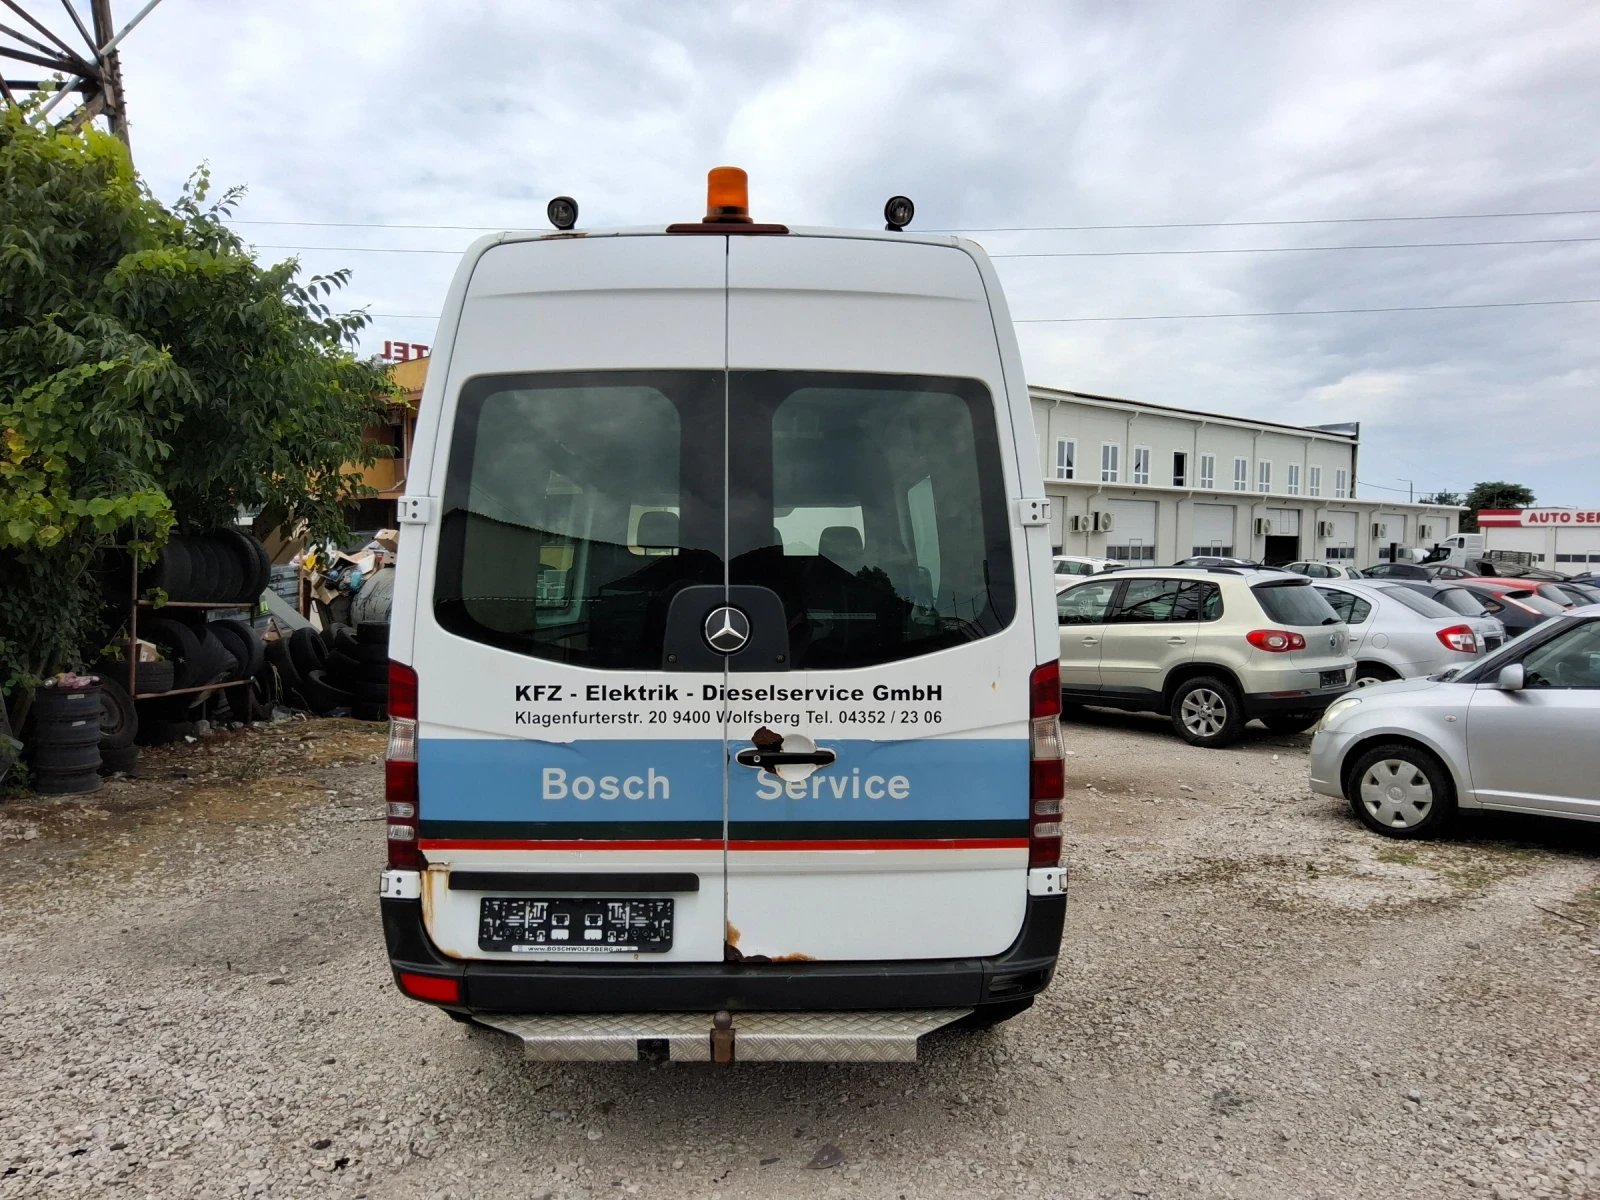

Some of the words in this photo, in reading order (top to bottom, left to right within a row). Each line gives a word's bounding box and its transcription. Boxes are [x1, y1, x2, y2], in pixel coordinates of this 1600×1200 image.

[1528, 512, 1571, 523] AUTO
[515, 685, 563, 701] KFZ
[586, 685, 679, 701] Elektrik
[702, 684, 864, 701] Dieselservice
[872, 685, 943, 701] GmbH
[515, 711, 643, 727] Klagenfurterstr.
[648, 711, 667, 724] 20
[672, 711, 711, 724] 9400
[716, 710, 800, 727] Wolfsberg
[805, 711, 833, 724] Tel.
[838, 711, 886, 724] 04352
[900, 711, 919, 724] 23
[924, 711, 942, 724] 06
[542, 767, 670, 800] Bosch
[756, 767, 910, 800] Service
